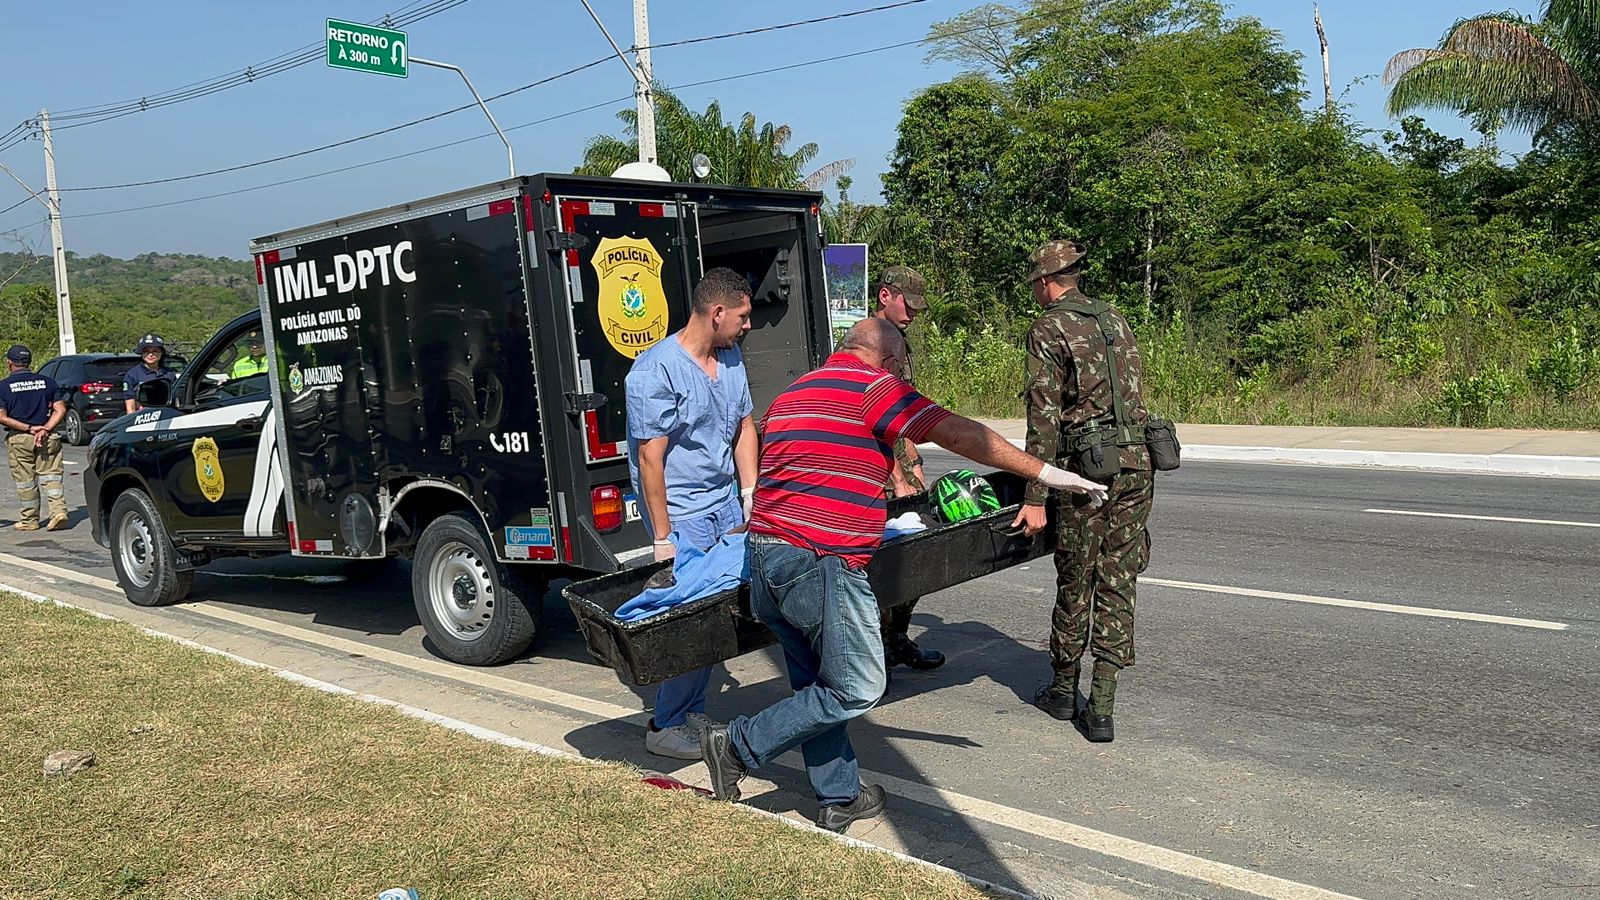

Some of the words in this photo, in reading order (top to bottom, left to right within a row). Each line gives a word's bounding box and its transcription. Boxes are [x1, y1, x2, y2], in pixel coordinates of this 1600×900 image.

[328, 28, 388, 49] RETORNO
[338, 44, 347, 60] À
[349, 50, 368, 63] 300
[370, 55, 380, 65] m
[608, 247, 650, 265] POLÍCIA
[273, 240, 418, 304] IML-DPTC
[280, 310, 317, 331] POLÍCIA
[318, 309, 346, 327] CIVIL
[347, 306, 362, 321] DO
[297, 325, 349, 346] AMAZONAS
[621, 331, 654, 345] CIVIL
[304, 365, 344, 385] AMAZONAS
[502, 431, 530, 453] 181
[510, 528, 548, 544] Ranam
